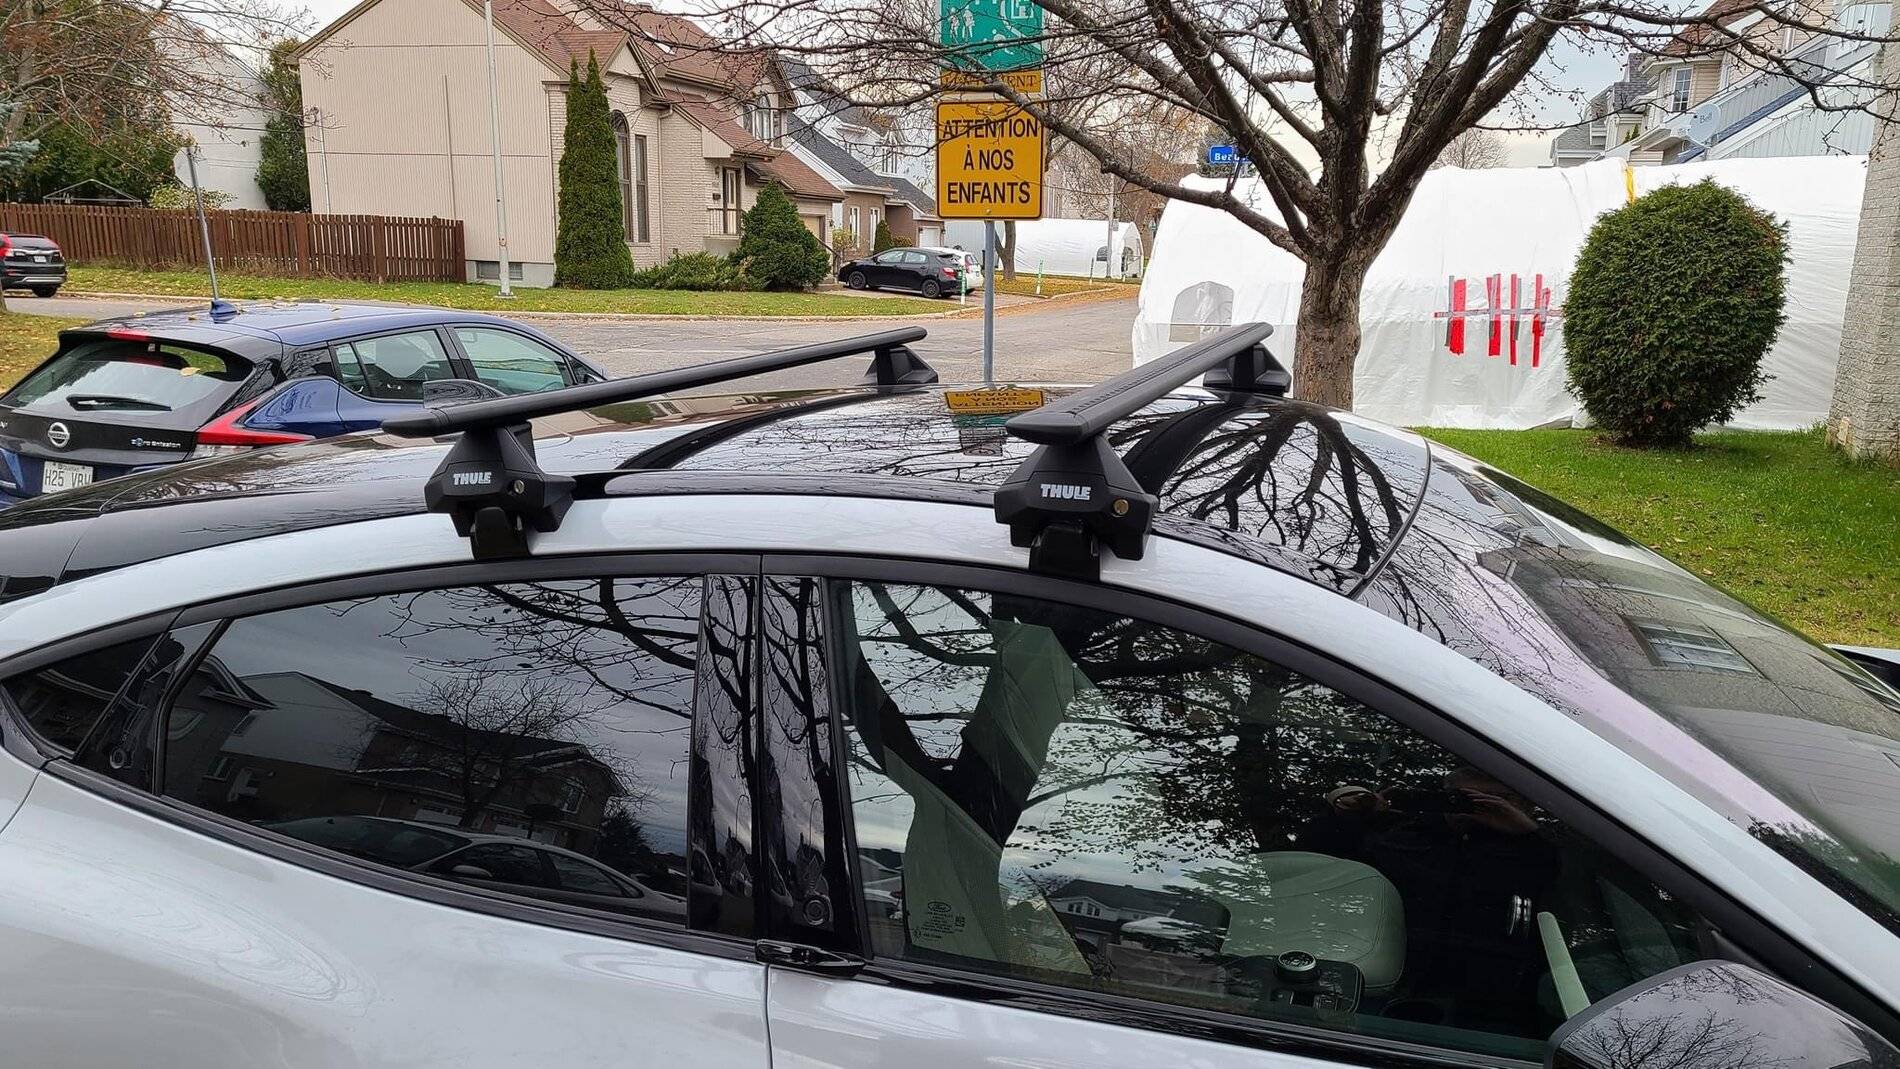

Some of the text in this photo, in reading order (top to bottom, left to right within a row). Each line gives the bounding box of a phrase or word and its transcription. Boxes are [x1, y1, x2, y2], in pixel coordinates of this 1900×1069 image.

[942, 118, 1038, 138] ATTENTION
[963, 144, 1014, 171] À NOS
[947, 182, 1031, 204] ENFANTS
[44, 469, 65, 487] H25
[453, 472, 492, 485] THULE
[1040, 483, 1091, 500] THULE
